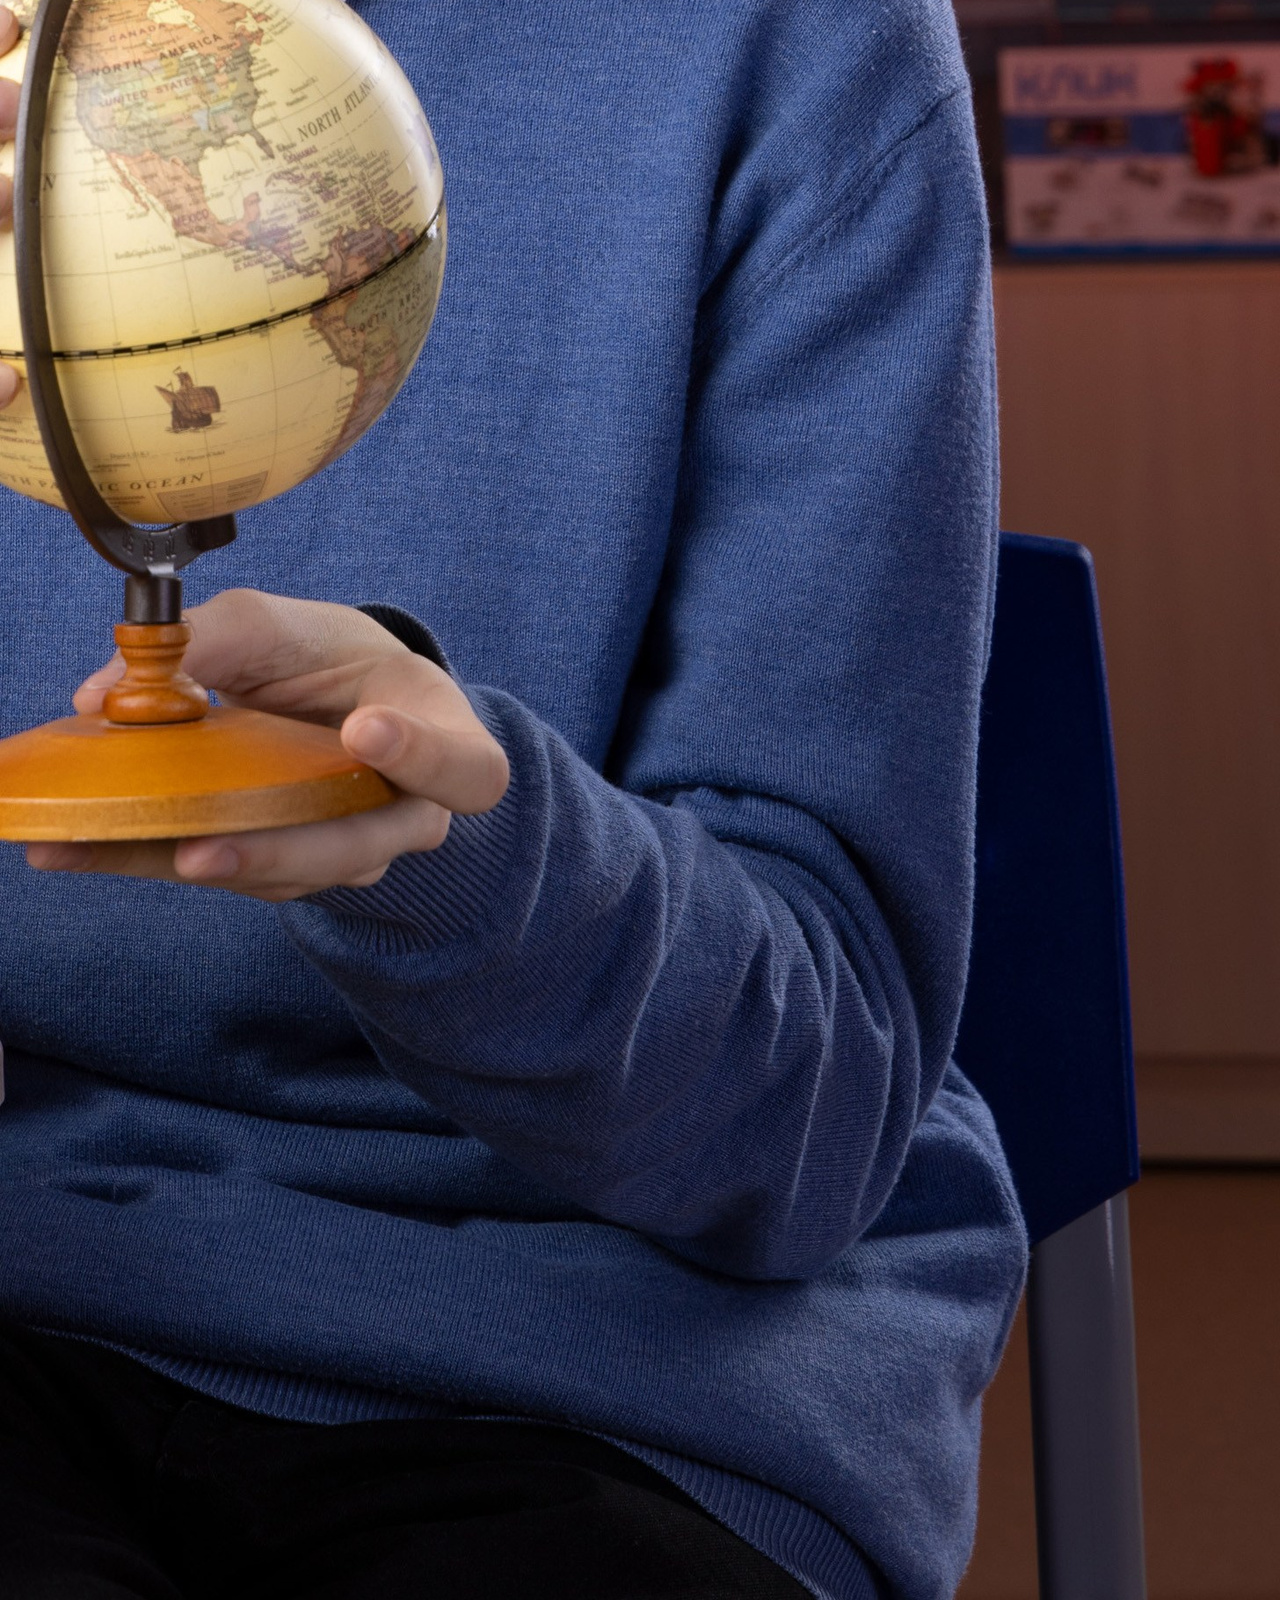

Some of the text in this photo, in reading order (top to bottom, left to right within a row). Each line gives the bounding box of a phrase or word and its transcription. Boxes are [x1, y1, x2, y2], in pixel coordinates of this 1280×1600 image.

[109, 23, 168, 43] CANADA
[91, 33, 223, 77] NORTH AMERICA
[102, 74, 202, 106] UNITED STATES
[297, 108, 342, 142] NORTH
[172, 208, 210, 227] MEXICO
[130, 472, 205, 491] OCEAN
